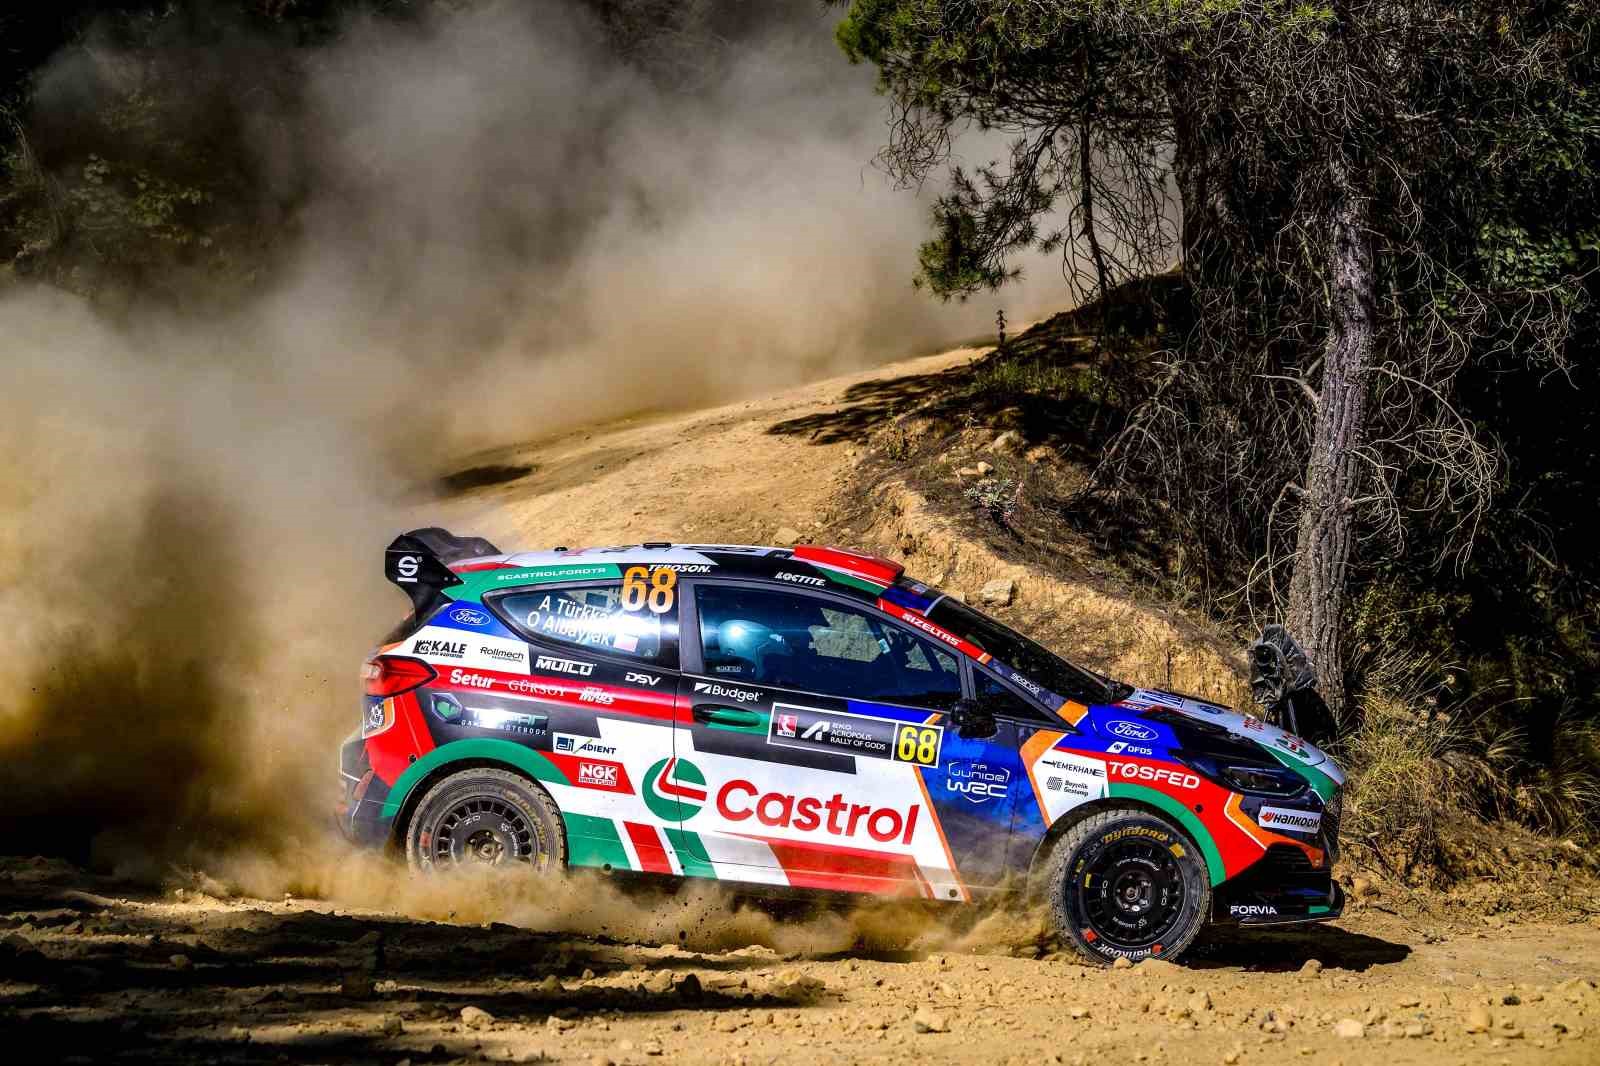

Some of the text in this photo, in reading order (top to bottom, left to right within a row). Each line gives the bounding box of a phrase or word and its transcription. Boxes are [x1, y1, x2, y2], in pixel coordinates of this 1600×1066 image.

[774, 571, 825, 586] LOCTITE
[622, 566, 678, 614] 68
[454, 609, 485, 625] Ford
[539, 595, 617, 623] A Türkka
[527, 611, 541, 628] O
[431, 640, 468, 655] KALE
[480, 645, 525, 661] Rollmech
[535, 655, 595, 677] MUTLU
[450, 668, 496, 689] Setur
[625, 671, 661, 686] DSV
[711, 685, 760, 702] Budget
[1113, 720, 1151, 740] Ford
[580, 743, 617, 755] ADIENT
[829, 736, 886, 751] RALLY OF GODS
[898, 726, 938, 764] 68
[581, 764, 617, 782] NGK
[971, 763, 988, 771] FIA
[1108, 760, 1201, 790] TOSFED
[951, 769, 1006, 783] JUNIOR
[946, 778, 1008, 799] WRC
[716, 779, 920, 845] Castrol
[1230, 905, 1278, 915] FORVIA
